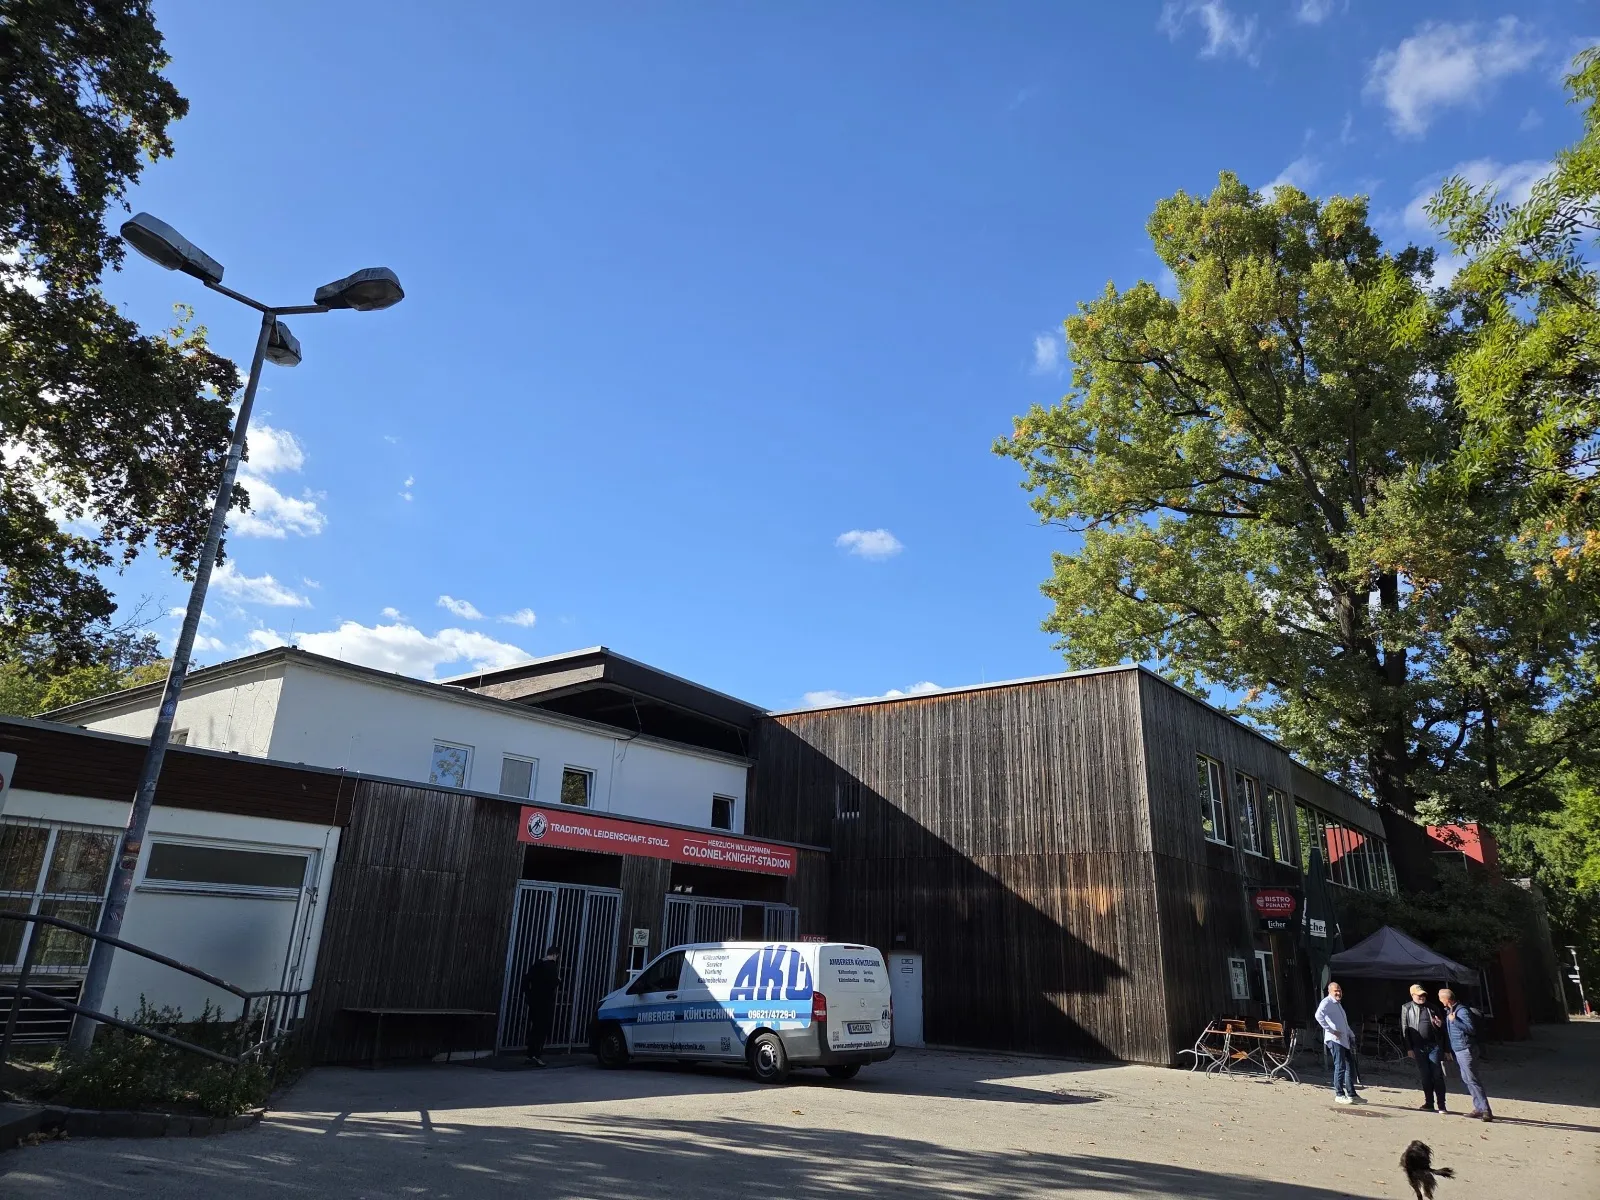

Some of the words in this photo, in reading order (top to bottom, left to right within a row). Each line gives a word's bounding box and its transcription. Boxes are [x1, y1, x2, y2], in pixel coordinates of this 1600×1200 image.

[550, 823, 592, 837] TRADITION.
[593, 829, 647, 844] LEIDENSCHAFT.
[647, 837, 670, 847] STOLZ.
[707, 839, 735, 850] HERZLICH
[735, 844, 771, 855] WILLKOMMEN
[682, 845, 791, 869] COLONEL-KNIGHT-STADION
[1267, 920, 1286, 929] Licher
[637, 1010, 676, 1023] AMBERGER
[683, 1007, 735, 1021] KÜHLTECHNIK
[748, 1009, 796, 1019] 09621/4729-0
